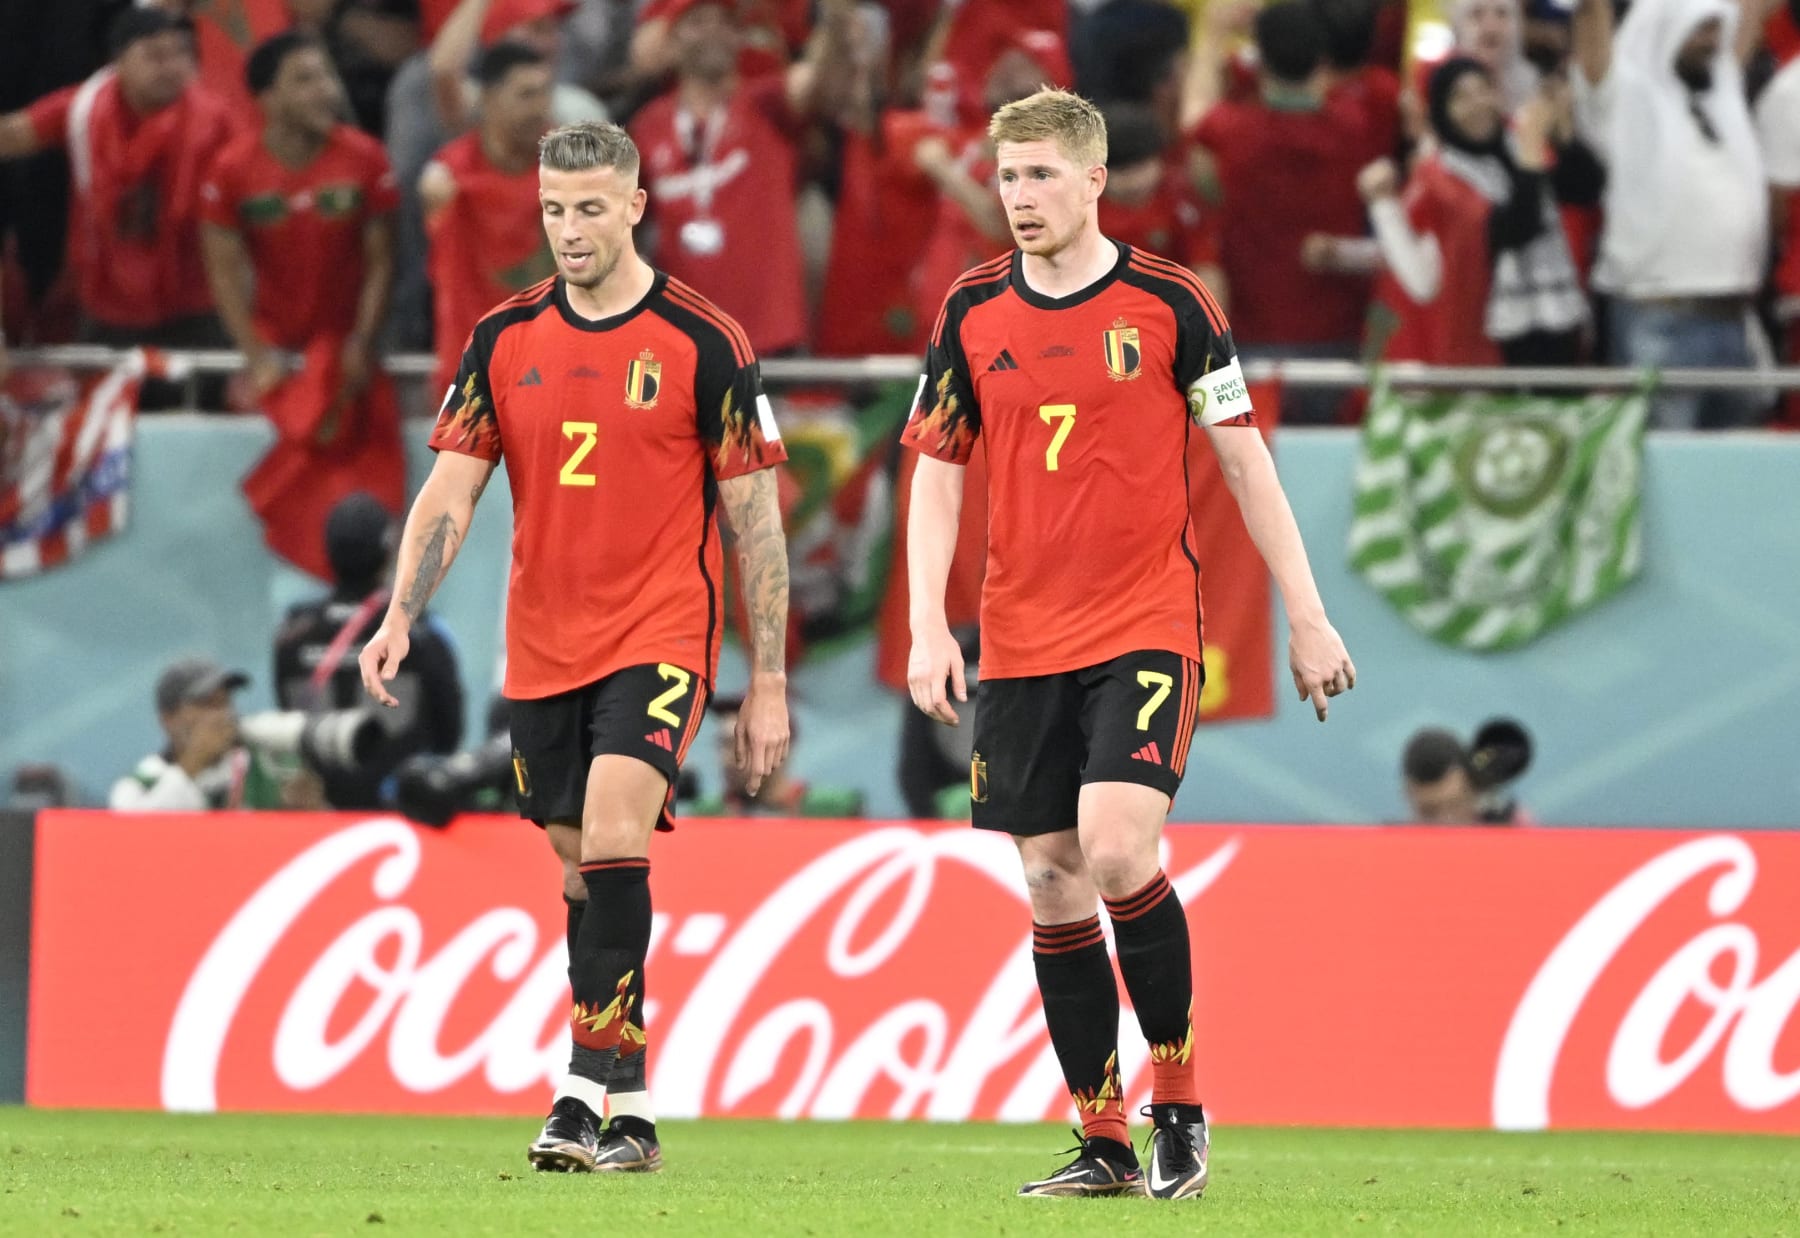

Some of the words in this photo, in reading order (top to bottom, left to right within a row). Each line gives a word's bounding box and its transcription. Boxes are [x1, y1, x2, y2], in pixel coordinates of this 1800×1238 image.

[1213, 378, 1240, 395] SAVE
[559, 421, 598, 486] 2
[1039, 404, 1077, 471] 7
[647, 662, 690, 728] 2
[1136, 670, 1173, 731] 7
